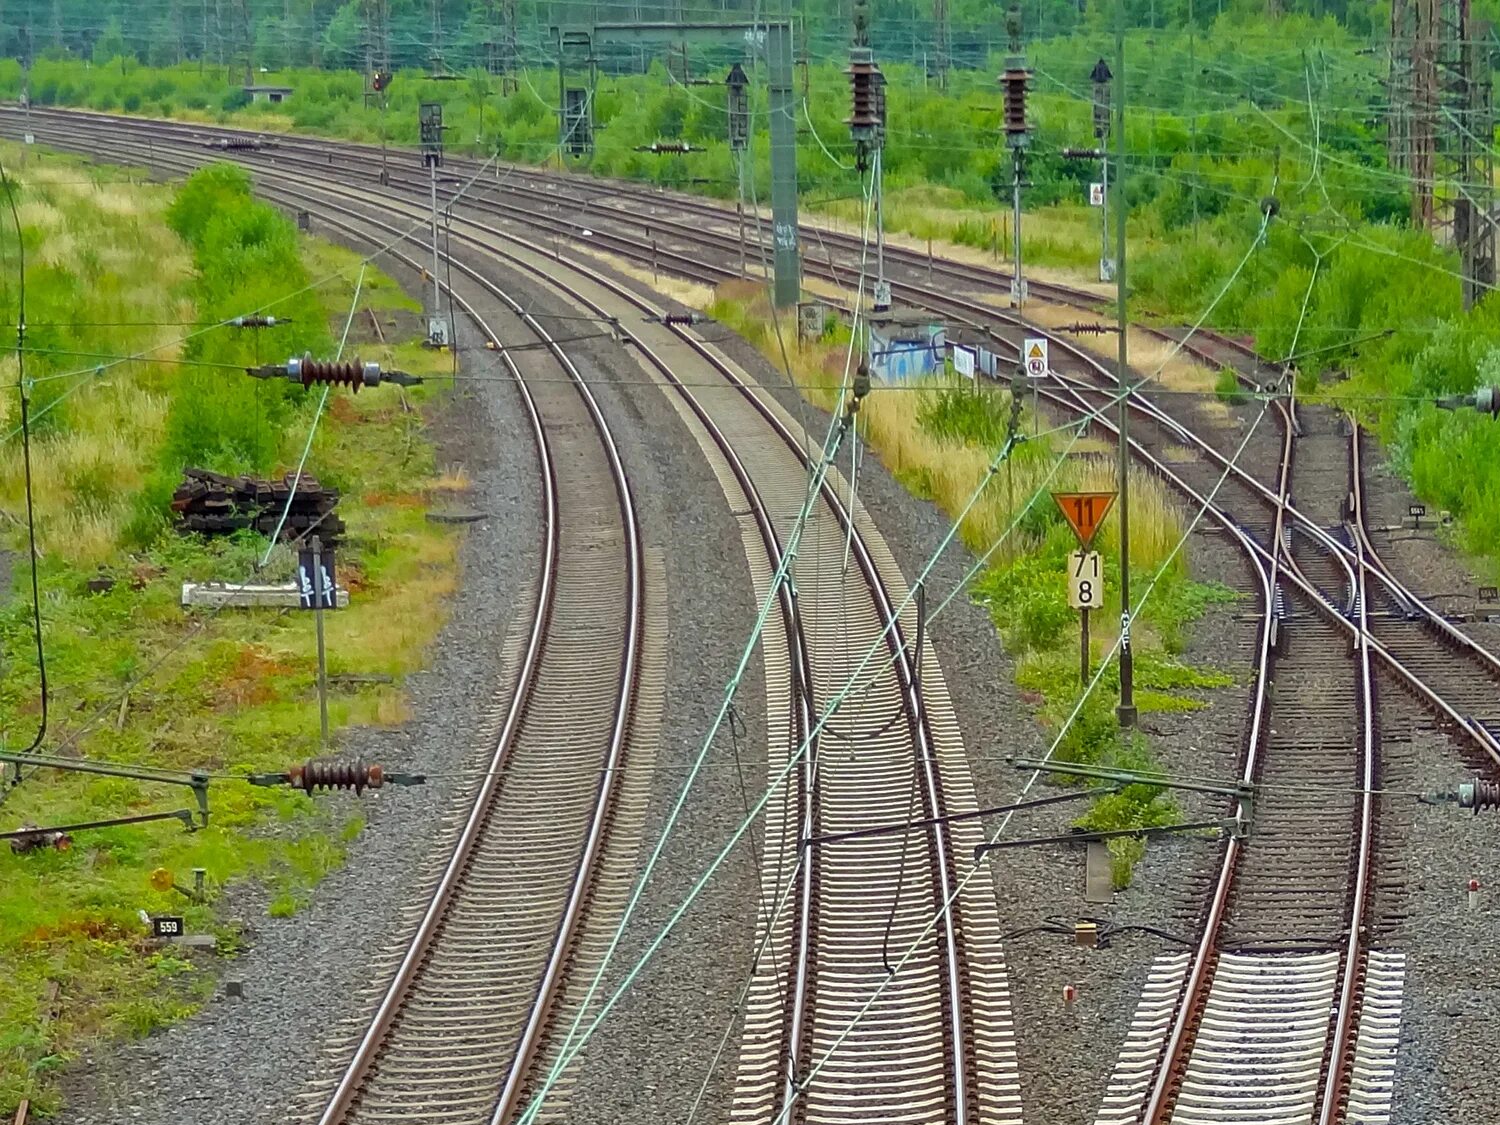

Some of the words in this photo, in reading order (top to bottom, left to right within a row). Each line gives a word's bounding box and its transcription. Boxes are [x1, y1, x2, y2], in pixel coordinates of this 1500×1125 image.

[1074, 499, 1093, 527] 11
[1074, 554, 1098, 577] 71
[1079, 580, 1092, 603] 8
[160, 921, 178, 933] 559
